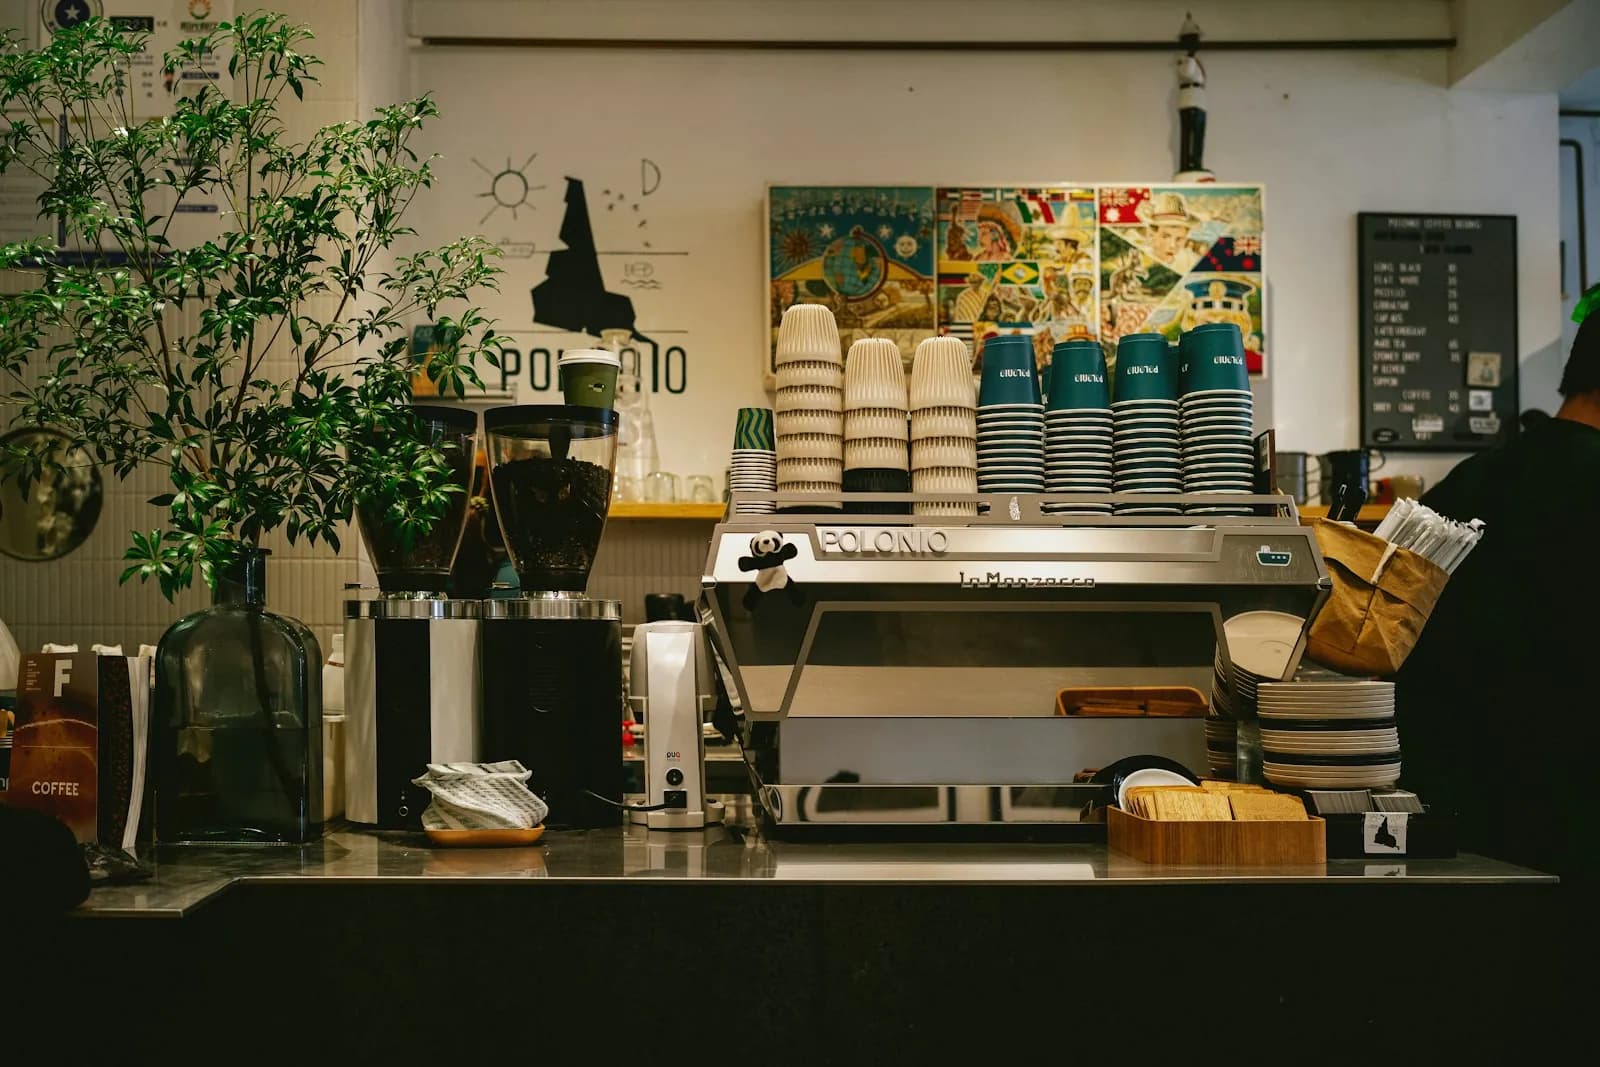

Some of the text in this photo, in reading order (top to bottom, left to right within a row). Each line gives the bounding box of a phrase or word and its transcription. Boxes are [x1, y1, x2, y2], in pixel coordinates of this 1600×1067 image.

[821, 530, 948, 557] POLONIO
[53, 659, 73, 697] F
[31, 780, 80, 797] COFFEE
